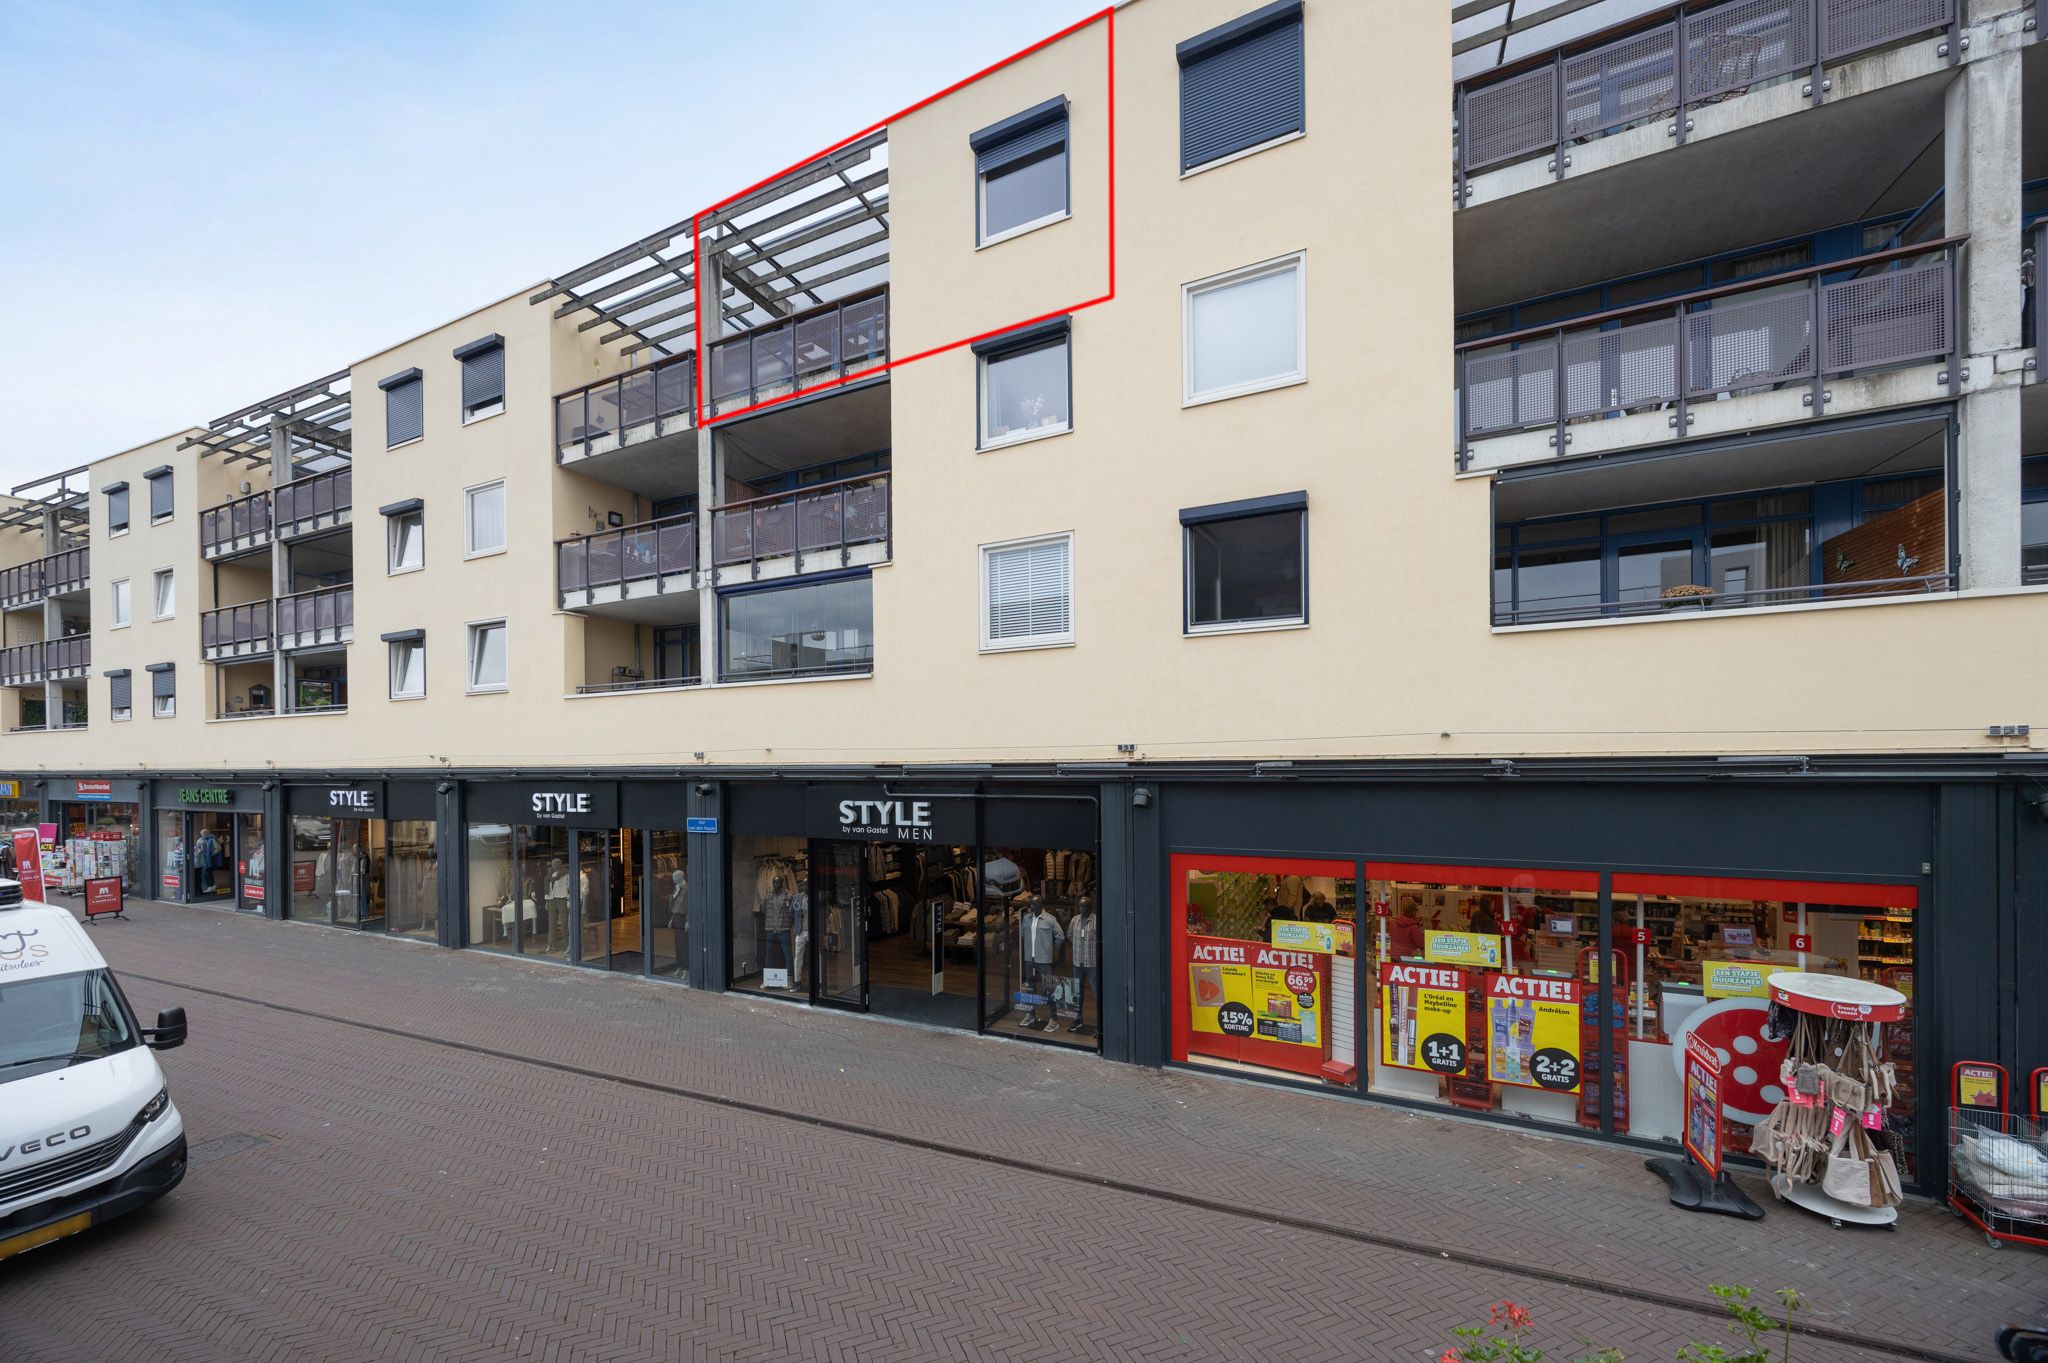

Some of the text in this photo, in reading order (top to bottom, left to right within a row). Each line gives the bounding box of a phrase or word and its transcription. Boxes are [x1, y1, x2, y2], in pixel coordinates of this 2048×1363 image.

[178, 788, 229, 804] JEANS CENTRE
[330, 790, 369, 806] STYLE
[532, 792, 589, 813] STYLE
[839, 800, 931, 827] STYLE
[842, 826, 850, 834] by
[898, 828, 932, 840] MEN
[1377, 905, 1383, 914] 3
[1508, 923, 1514, 933] 4
[1637, 931, 1646, 941] 5
[1432, 943, 1469, 951] DUURZAMER
[1796, 937, 1805, 949] 6
[1193, 945, 1246, 962] ACTIE!
[1257, 949, 1314, 970] ACTIE!
[1389, 965, 1459, 988] ACTIE!
[1713, 977, 1762, 986] DUURZAMER
[1494, 976, 1572, 1001] ACTIE!
[1424, 993, 1445, 1001] L'Oréal
[1424, 999, 1457, 1008] Maybelline
[1837, 1004, 1858, 1012] Trendy
[1424, 1006, 1452, 1014] make-up
[1538, 1006, 1570, 1015] Andrélon
[1221, 1010, 1253, 1025] 15%
[1224, 1023, 1249, 1032] KORTING
[1428, 1041, 1461, 1060] 1+1
[1693, 1038, 1718, 1069] Kruidvat
[1431, 1057, 1458, 1067] GRATIS
[1535, 1055, 1575, 1077] 2+2
[1541, 1073, 1570, 1083] GRATIS
[1690, 1060, 1717, 1094] ACTIE!
[1963, 1068, 1993, 1078] ACTIE!
